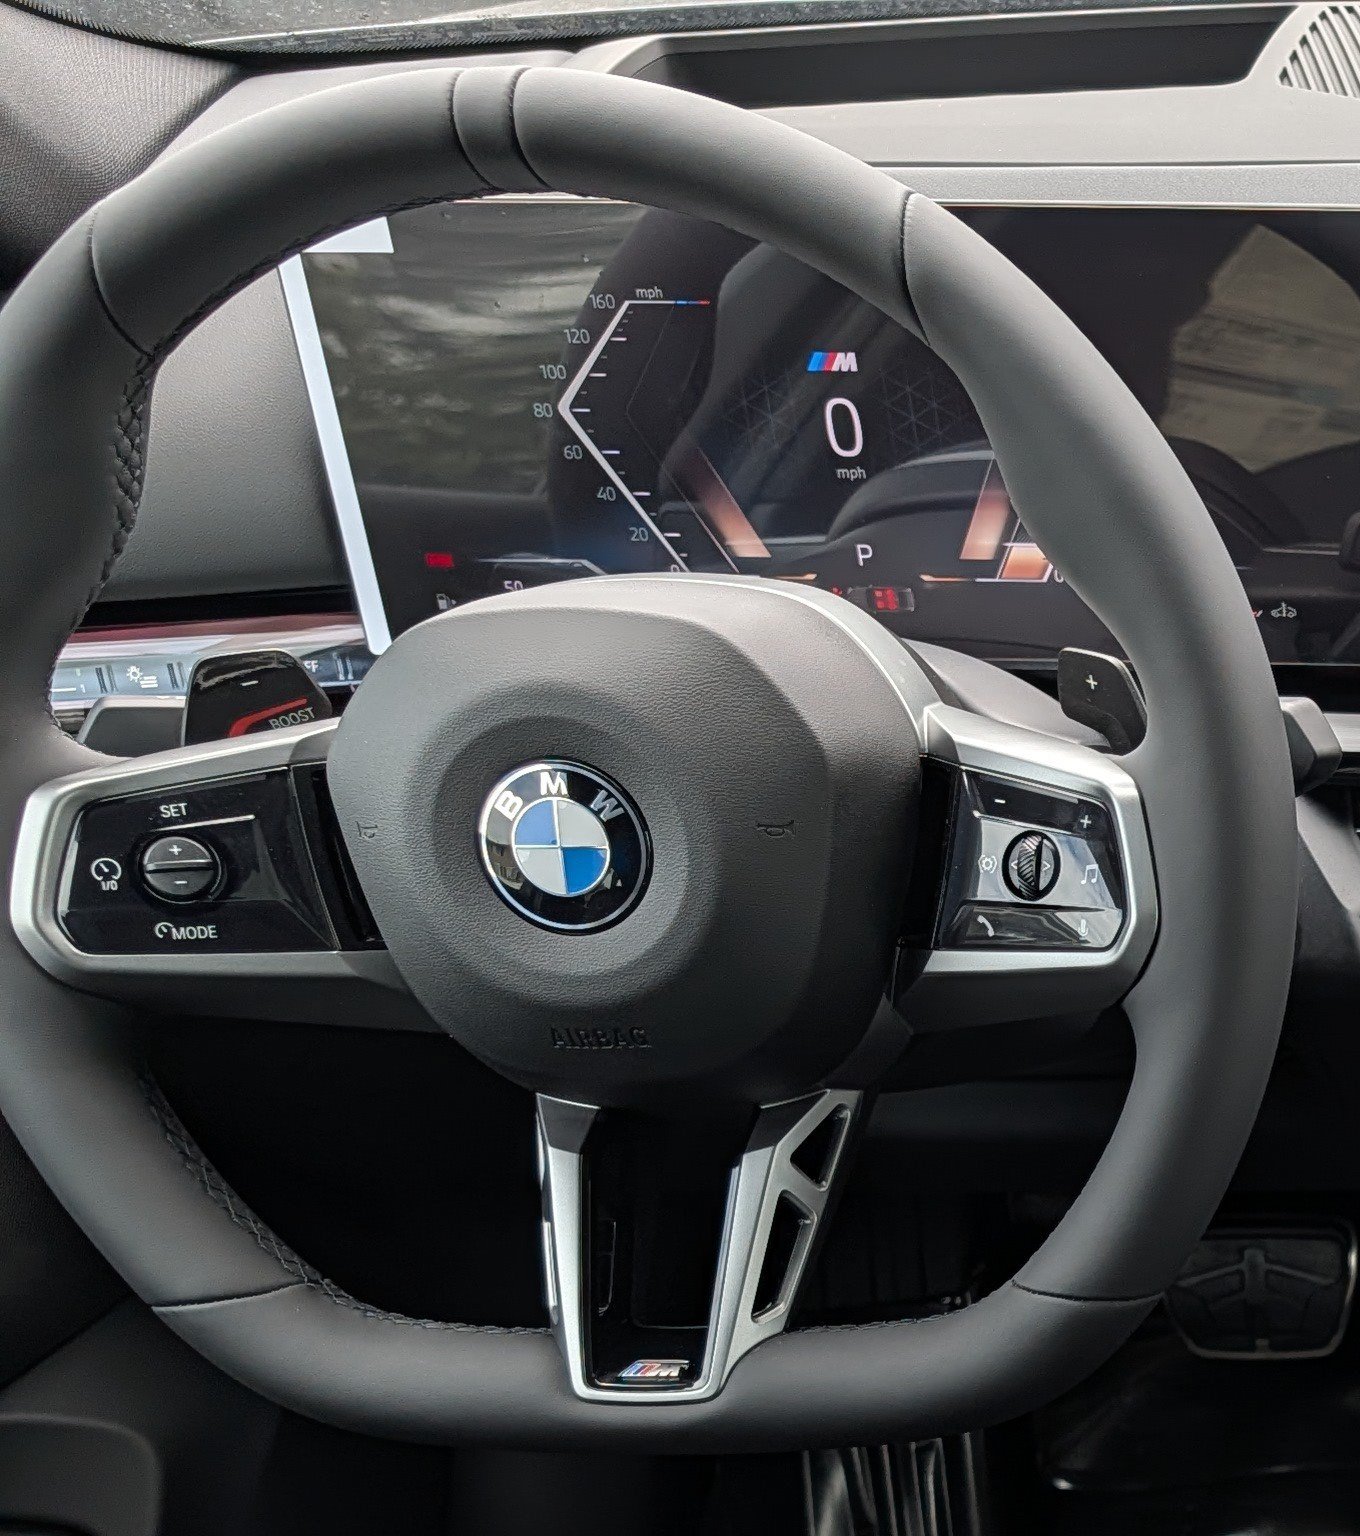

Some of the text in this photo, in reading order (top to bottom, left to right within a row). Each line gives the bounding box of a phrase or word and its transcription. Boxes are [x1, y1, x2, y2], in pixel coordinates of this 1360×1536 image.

[635, 286, 663, 300] mph
[589, 294, 615, 309] 160
[564, 329, 590, 344] 120
[539, 365, 567, 380] 100
[533, 402, 553, 418] 80
[825, 397, 863, 457] 0
[563, 445, 583, 460] 60
[835, 466, 867, 481] mph
[597, 486, 616, 501] 40
[629, 527, 649, 542] 20
[856, 543, 873, 566] P
[269, 707, 316, 730] BOOST
[494, 771, 625, 823] BMW
[159, 802, 188, 818] SET
[171, 925, 218, 940] MODE
